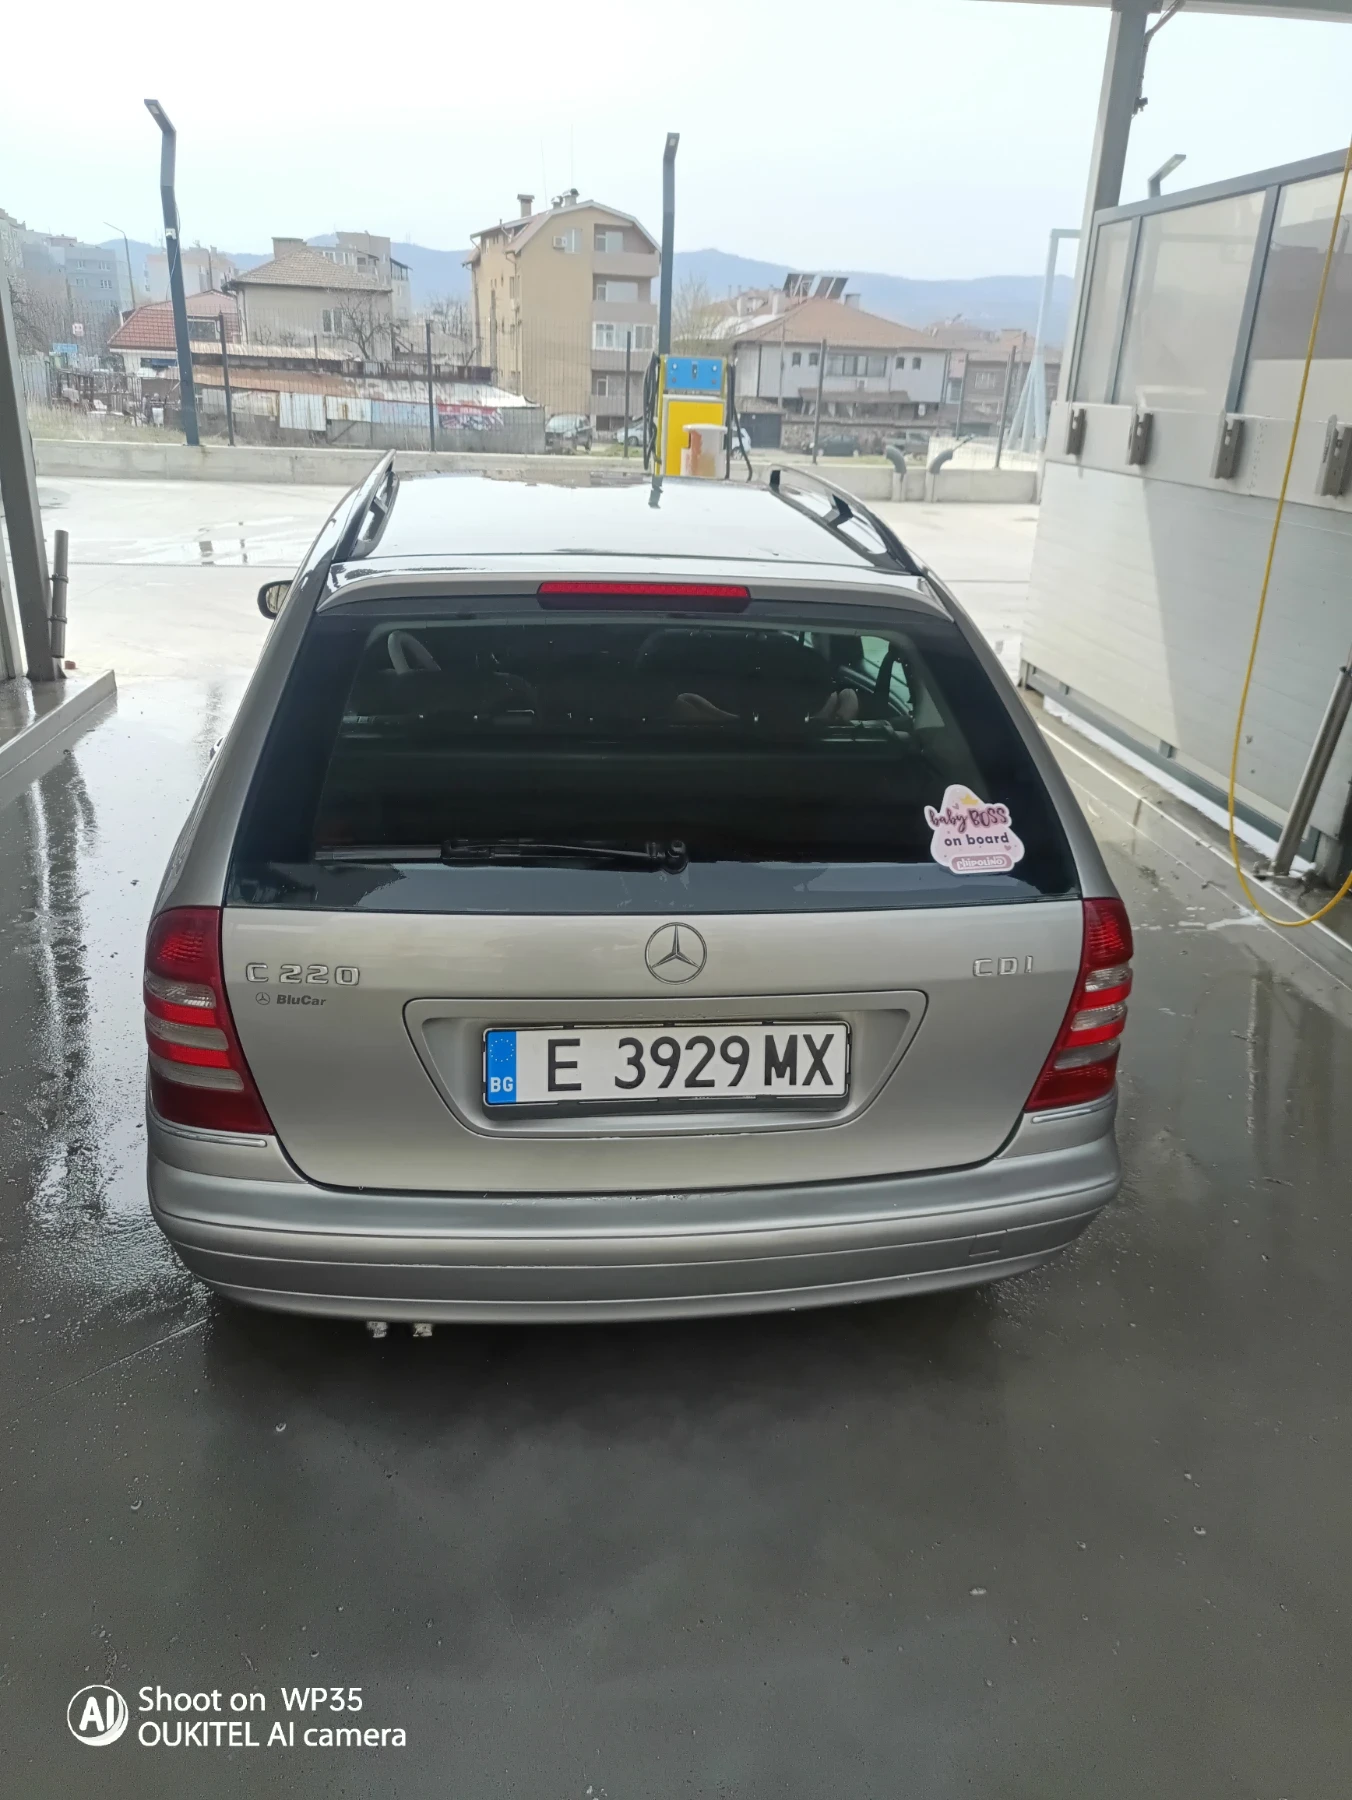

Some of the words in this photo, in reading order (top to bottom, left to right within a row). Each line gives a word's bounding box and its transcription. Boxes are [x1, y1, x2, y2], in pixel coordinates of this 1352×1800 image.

[929, 807, 967, 833] baby
[968, 807, 1007, 827] BOSS
[944, 837, 962, 847] on
[966, 832, 1009, 845] board
[246, 962, 269, 983] C
[279, 964, 360, 986] 220
[972, 955, 1033, 977] CDI
[276, 994, 326, 1006] BluCar
[547, 1038, 582, 1092] E
[614, 1035, 750, 1090] 3929
[764, 1033, 835, 1087] MX
[490, 1076, 514, 1093] BG
